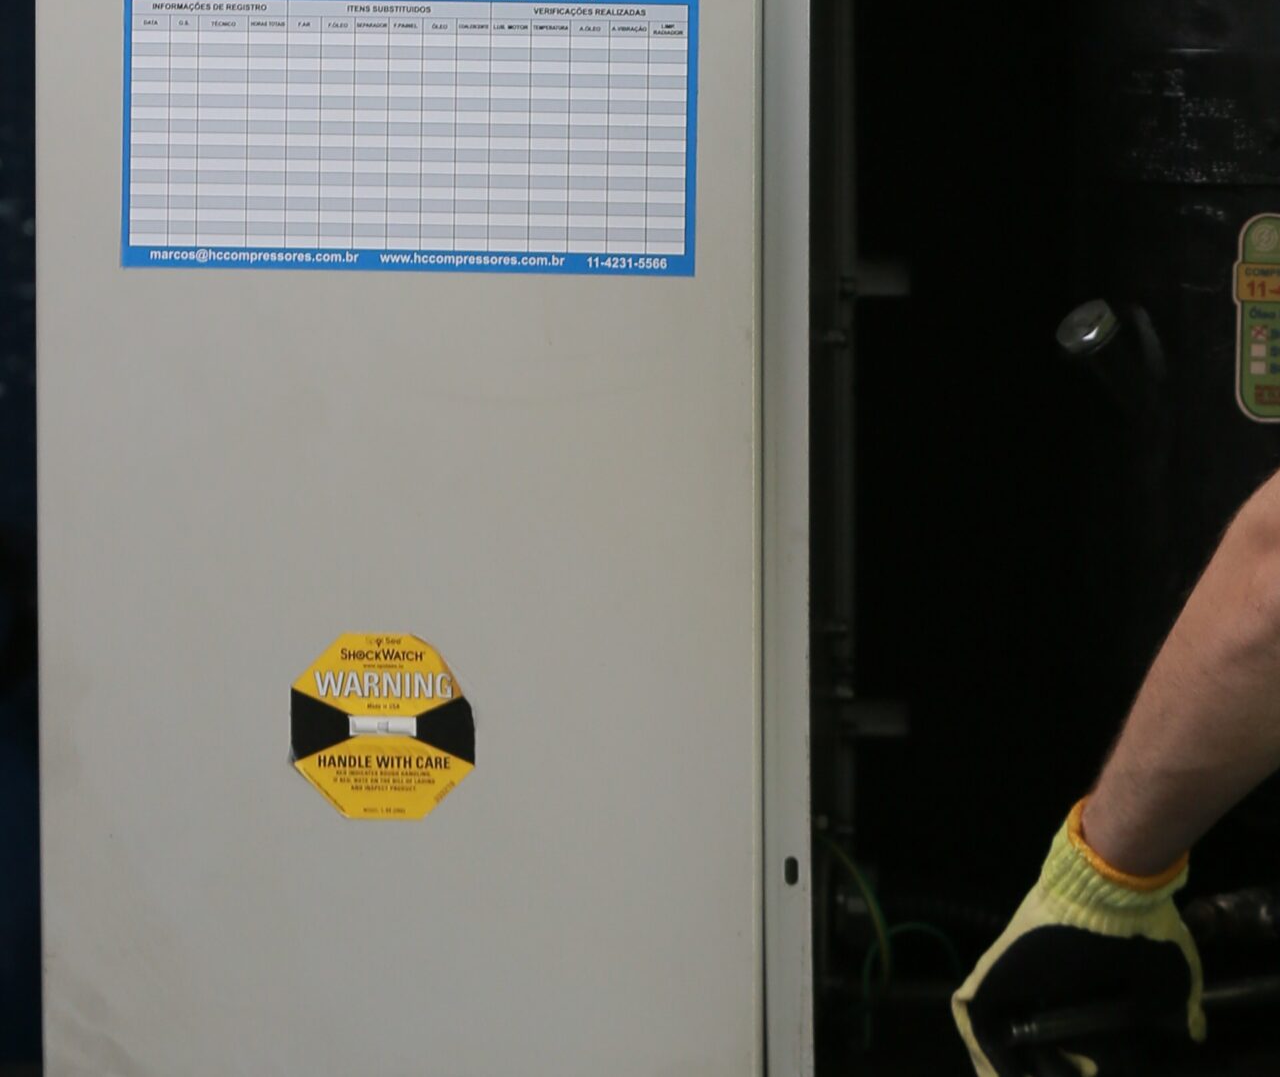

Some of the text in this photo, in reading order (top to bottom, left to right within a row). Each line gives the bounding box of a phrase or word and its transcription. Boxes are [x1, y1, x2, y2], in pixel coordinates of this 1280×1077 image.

[152, 2, 268, 13] INFORMAÇÕES DE REGISTRO
[346, 5, 431, 14] ITENS SUBSTITUIDOS
[533, 6, 646, 18] VERIFICAÇÕES REALIZADAS
[149, 248, 668, 270] marcos@hccompressores.com.br www.hccompressores.com.br 11-4231-5566
[313, 670, 454, 699] WARNING
[317, 754, 451, 770] HANDLE WITH CARE
